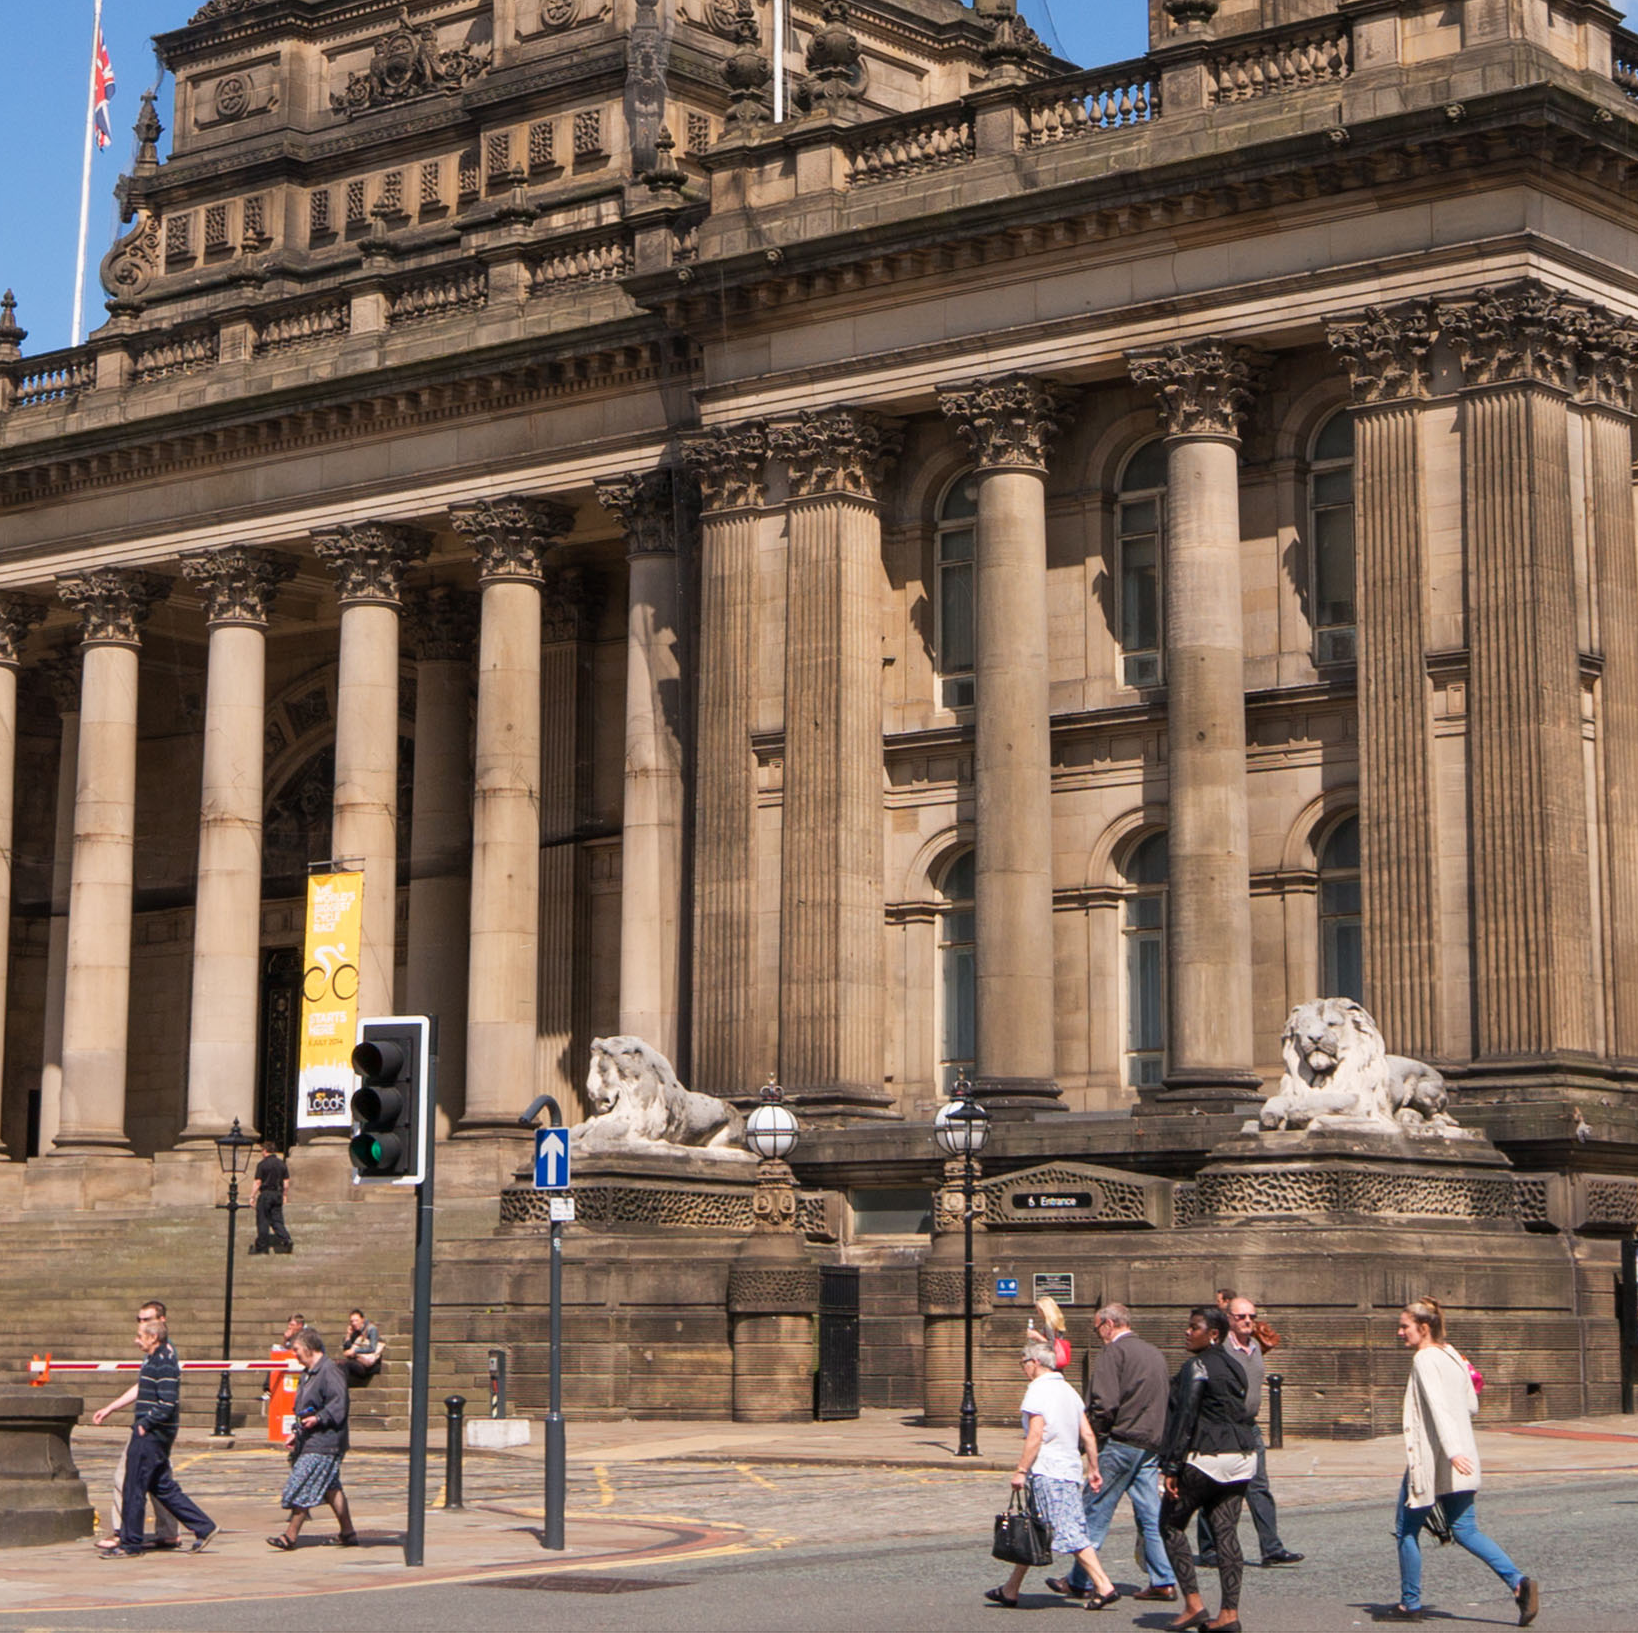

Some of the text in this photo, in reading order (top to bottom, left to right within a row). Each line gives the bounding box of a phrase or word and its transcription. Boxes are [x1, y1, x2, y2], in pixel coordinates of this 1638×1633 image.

[309, 1011, 347, 1024] STARTS
[308, 1024, 336, 1036] HERE
[1040, 1196, 1077, 1207] Entrance
